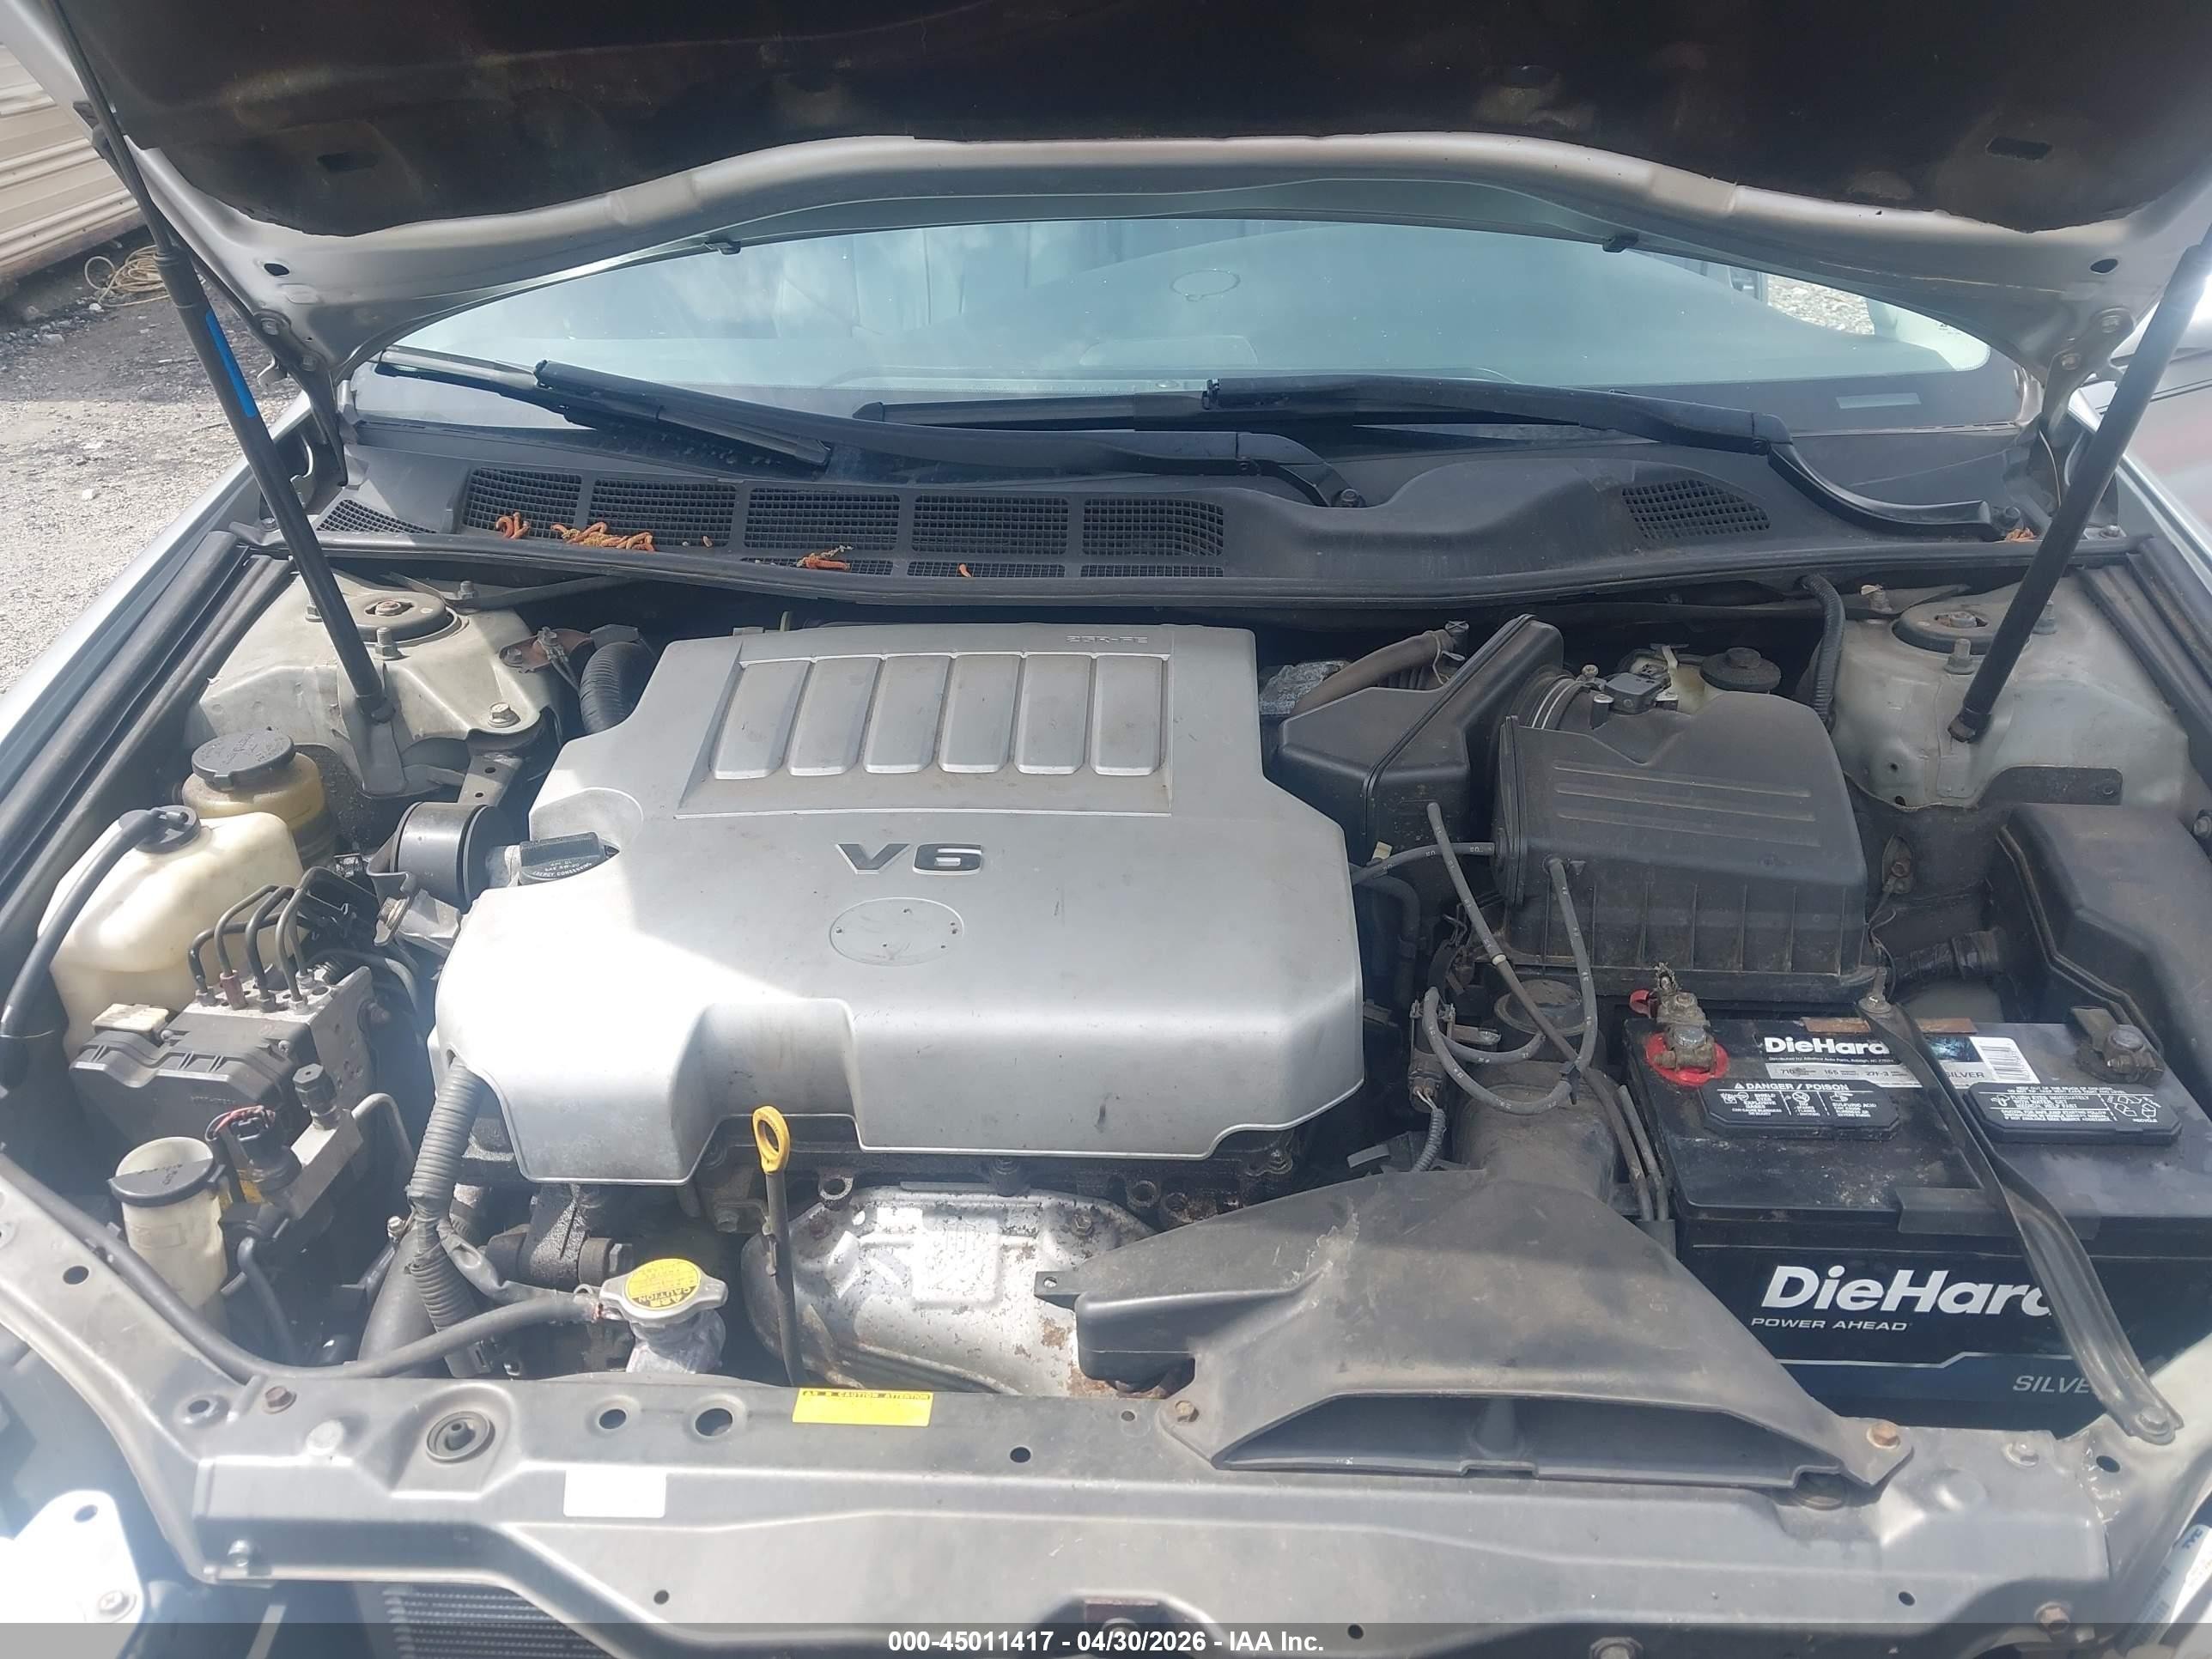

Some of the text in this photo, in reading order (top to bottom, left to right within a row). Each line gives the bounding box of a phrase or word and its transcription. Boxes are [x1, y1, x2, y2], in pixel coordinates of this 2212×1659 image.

[836, 842, 983, 875] V6
[638, 1288, 691, 1303] CAUTION
[1751, 1318, 1908, 1330] POWER AHEAD
[2013, 1376, 2088, 1393] SILVE
